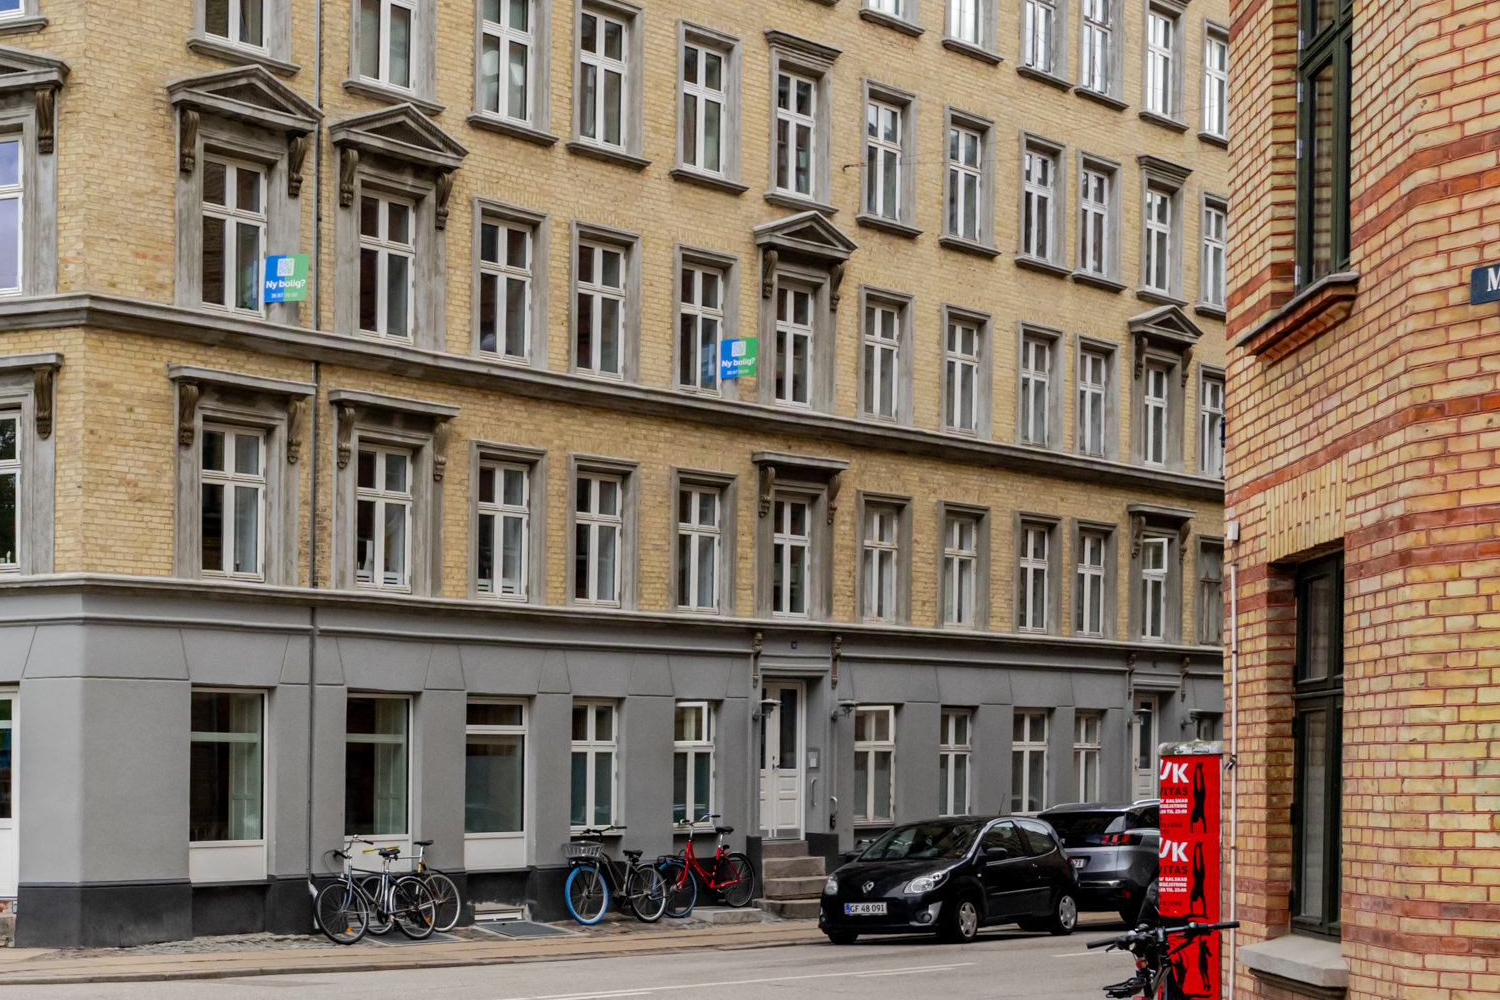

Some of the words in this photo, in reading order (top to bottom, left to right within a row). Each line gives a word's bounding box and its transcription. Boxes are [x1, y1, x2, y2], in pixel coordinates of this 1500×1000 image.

[266, 280, 278, 289] Ny
[279, 279, 306, 289] bolig?
[721, 360, 732, 368] Ny
[733, 357, 756, 366] bolig?
[861, 904, 870, 912] 48
[871, 904, 884, 912] 091
